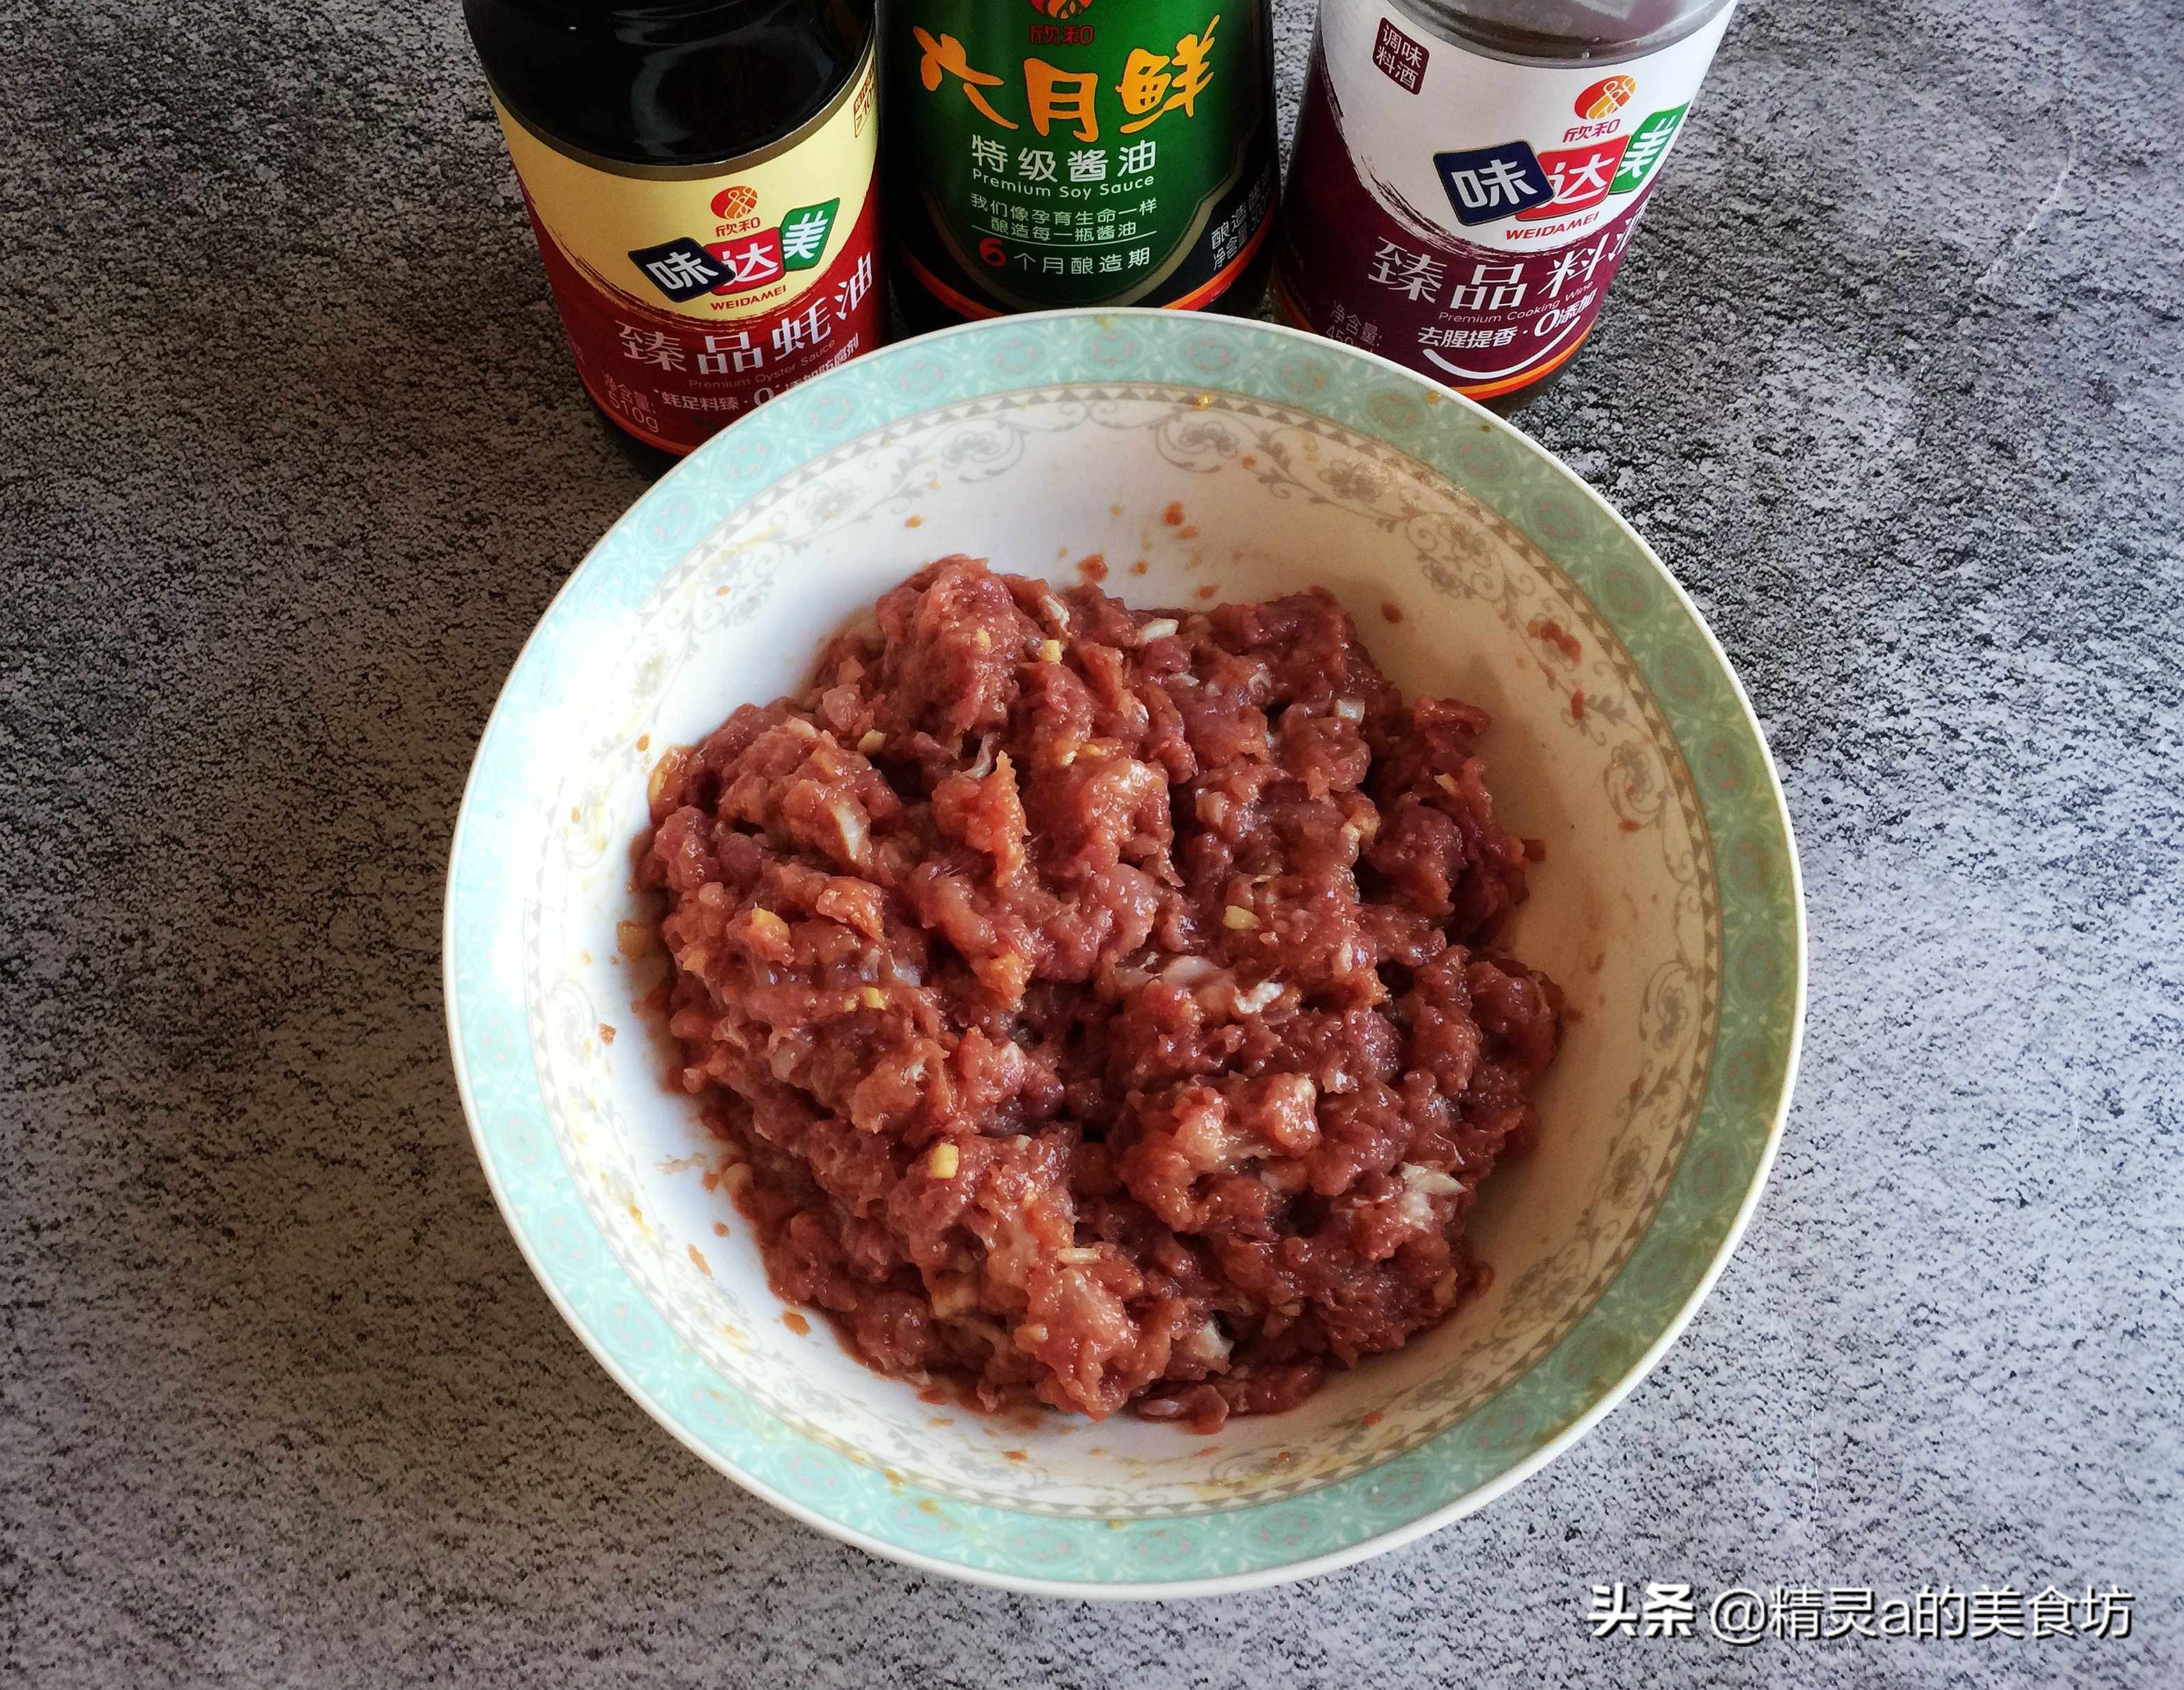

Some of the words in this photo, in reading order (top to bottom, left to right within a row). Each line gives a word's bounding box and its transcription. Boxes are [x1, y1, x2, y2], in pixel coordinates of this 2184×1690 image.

[1382, 24, 1422, 68] 调味
[912, 14, 1222, 143] 六月鲜
[1376, 45, 1419, 91] 料酒
[1562, 118, 1622, 143] 欣和
[971, 134, 1157, 183] 特级酱油
[1450, 114, 1677, 208] 味达美
[972, 169, 1051, 197] Premium
[1059, 184, 1092, 201] Soy
[1099, 174, 1155, 197] Sauce
[715, 217, 761, 238] 欣和
[970, 192, 1158, 227] 我们像孕育生命一样
[990, 217, 1137, 242] 酿造每一瓶酱油
[1505, 211, 1600, 241] WEIDAMEI
[645, 210, 829, 290] 味达美
[614, 251, 872, 375] 臻品蚝油
[710, 284, 786, 312] WEIDAMEI
[1438, 311, 1502, 323] Premium
[1507, 299, 1560, 321] Cooking
[1564, 280, 1594, 302] Wine
[689, 378, 751, 390] Premium
[754, 363, 797, 383] Oyster
[800, 339, 836, 367] Sauce
[608, 390, 659, 433] 510g
